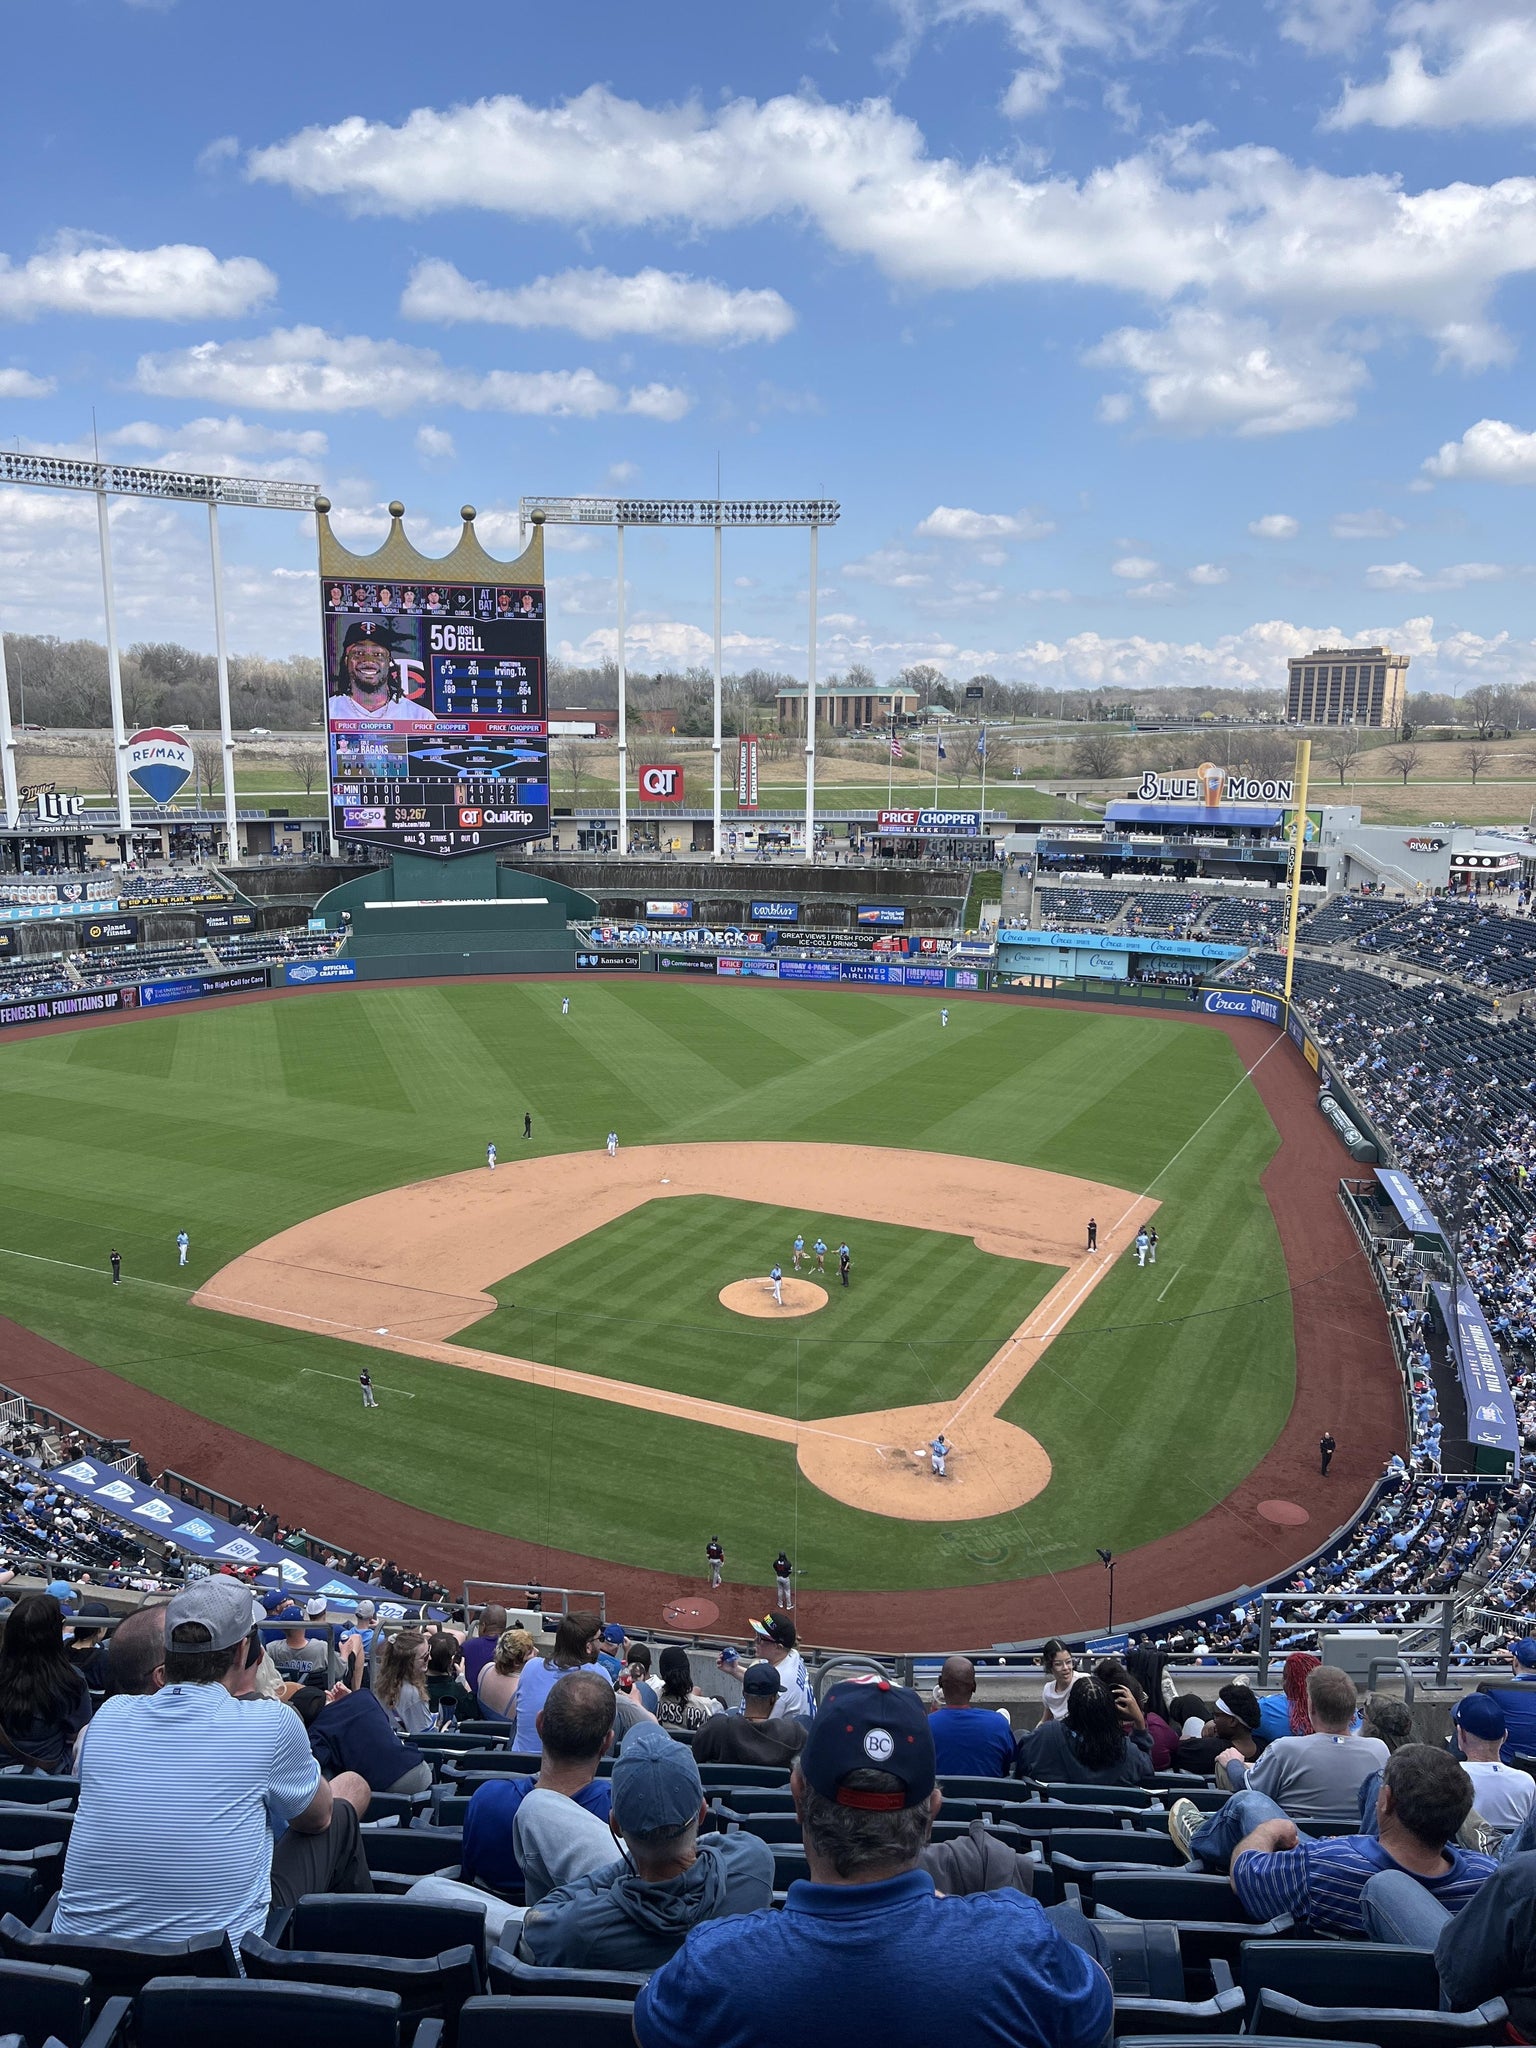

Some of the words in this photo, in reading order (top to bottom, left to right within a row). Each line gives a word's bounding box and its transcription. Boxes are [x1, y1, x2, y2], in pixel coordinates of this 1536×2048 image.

[343, 585, 352, 596] 16
[366, 585, 377, 597] 25
[481, 589, 490, 600] AT
[478, 600, 493, 611] BAT
[456, 625, 474, 636] JOSH
[430, 624, 457, 651] 56
[458, 636, 485, 652] BELL
[467, 665, 479, 676] 261
[518, 667, 527, 676] TX
[132, 748, 186, 762] RE/MAX
[360, 745, 389, 754] RAGANS
[643, 768, 677, 796] QT
[1138, 771, 1198, 801] BLUE
[1227, 776, 1294, 801] MOON
[21, 783, 56, 801] Miller
[343, 785, 359, 794] MIN
[346, 796, 357, 804] KC
[36, 792, 86, 824] Lite
[394, 808, 427, 821] $9,267
[461, 811, 478, 824] QT
[484, 810, 534, 825] QuikTrip
[882, 812, 915, 824] PRICE
[921, 813, 976, 825] CHOPPER
[418, 832, 426, 846] 3
[472, 832, 480, 844] 0
[1410, 842, 1439, 851] RIVALS
[754, 904, 794, 916] carbliss
[206, 917, 224, 925] planet
[103, 925, 126, 933] planet
[107, 929, 131, 937] fitness
[619, 930, 698, 943] FOUNTAIN
[704, 931, 745, 942] DECK
[749, 933, 759, 942] QT
[1002, 931, 1023, 942] Circa
[1051, 934, 1072, 945] Circa
[922, 940, 933, 949] QT
[1100, 937, 1122, 948] Circa
[1150, 941, 1172, 952] Circa
[1201, 945, 1224, 956] Circa
[625, 957, 638, 965] City
[671, 960, 699, 968] Commerce
[744, 962, 775, 970] CHOPPER
[1090, 954, 1114, 967] Circa
[1151, 956, 1178, 969] Circa
[850, 966, 885, 974] UNITED
[842, 972, 885, 980] AIRLINES
[215, 980, 230, 989] Right
[231, 979, 241, 987] Call
[1, 1004, 36, 1022] FENCES
[38, 1003, 51, 1018] IN,
[53, 995, 104, 1015] FOUNTAINS
[105, 993, 118, 1007] UP
[1205, 992, 1246, 1012] Circa
[1251, 999, 1277, 1019] SPORTS
[1469, 1324, 1490, 1352] CHAMPIONS
[1485, 1373, 1502, 1393] WORLD
[106, 1483, 130, 1499] 1977
[145, 1502, 169, 1517] 1978
[184, 1521, 210, 1537] 1980
[228, 1541, 252, 1561] 1981
[868, 1736, 890, 1752] BC
